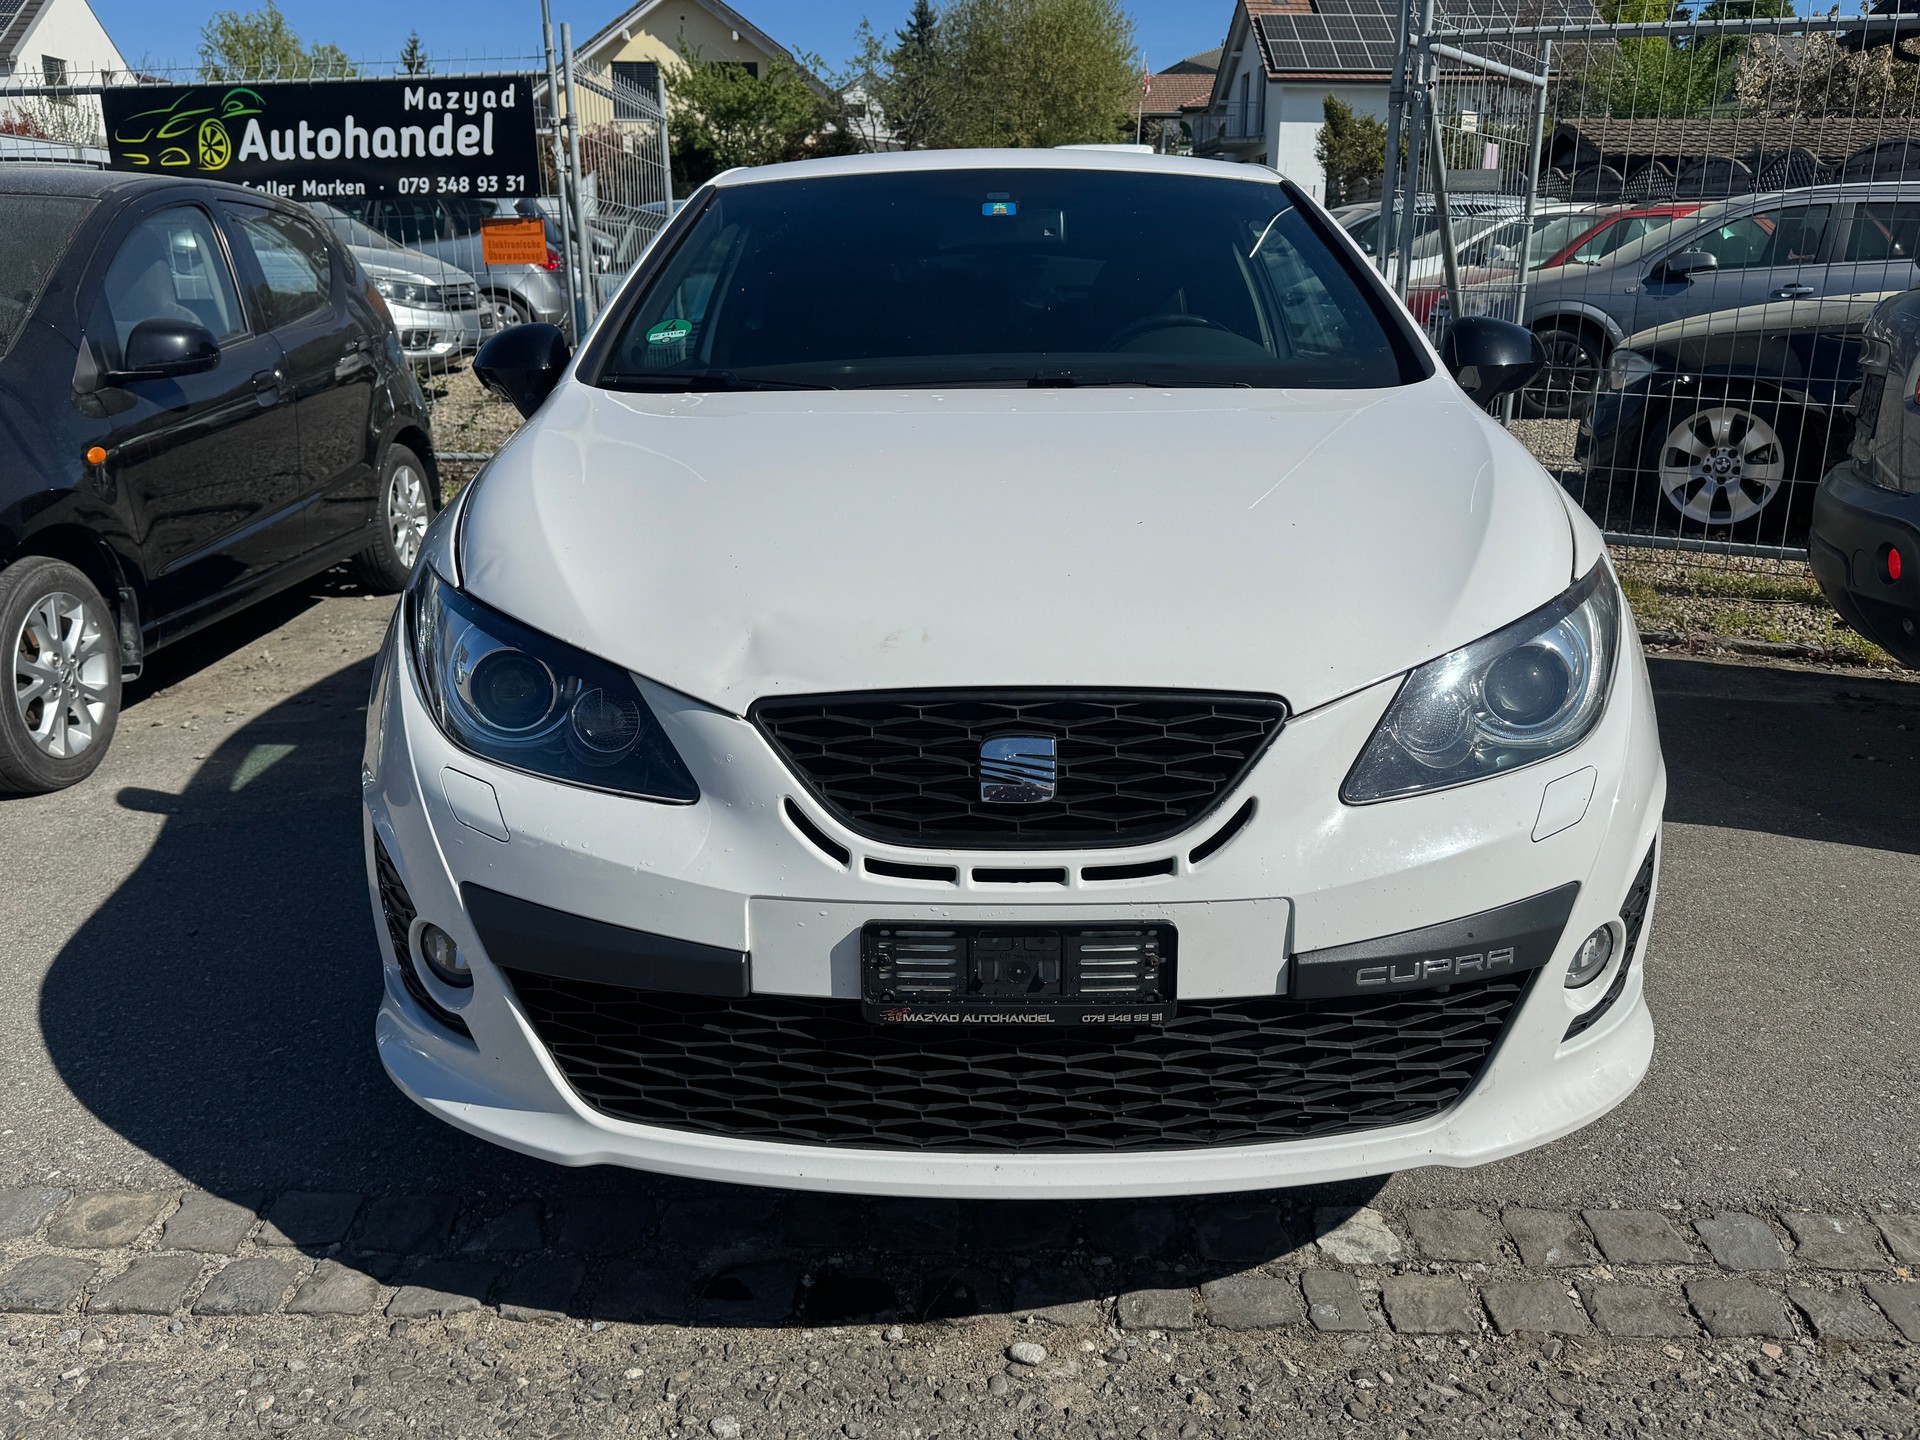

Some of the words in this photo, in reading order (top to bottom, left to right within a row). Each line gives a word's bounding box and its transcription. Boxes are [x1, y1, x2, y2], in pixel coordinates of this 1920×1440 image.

[404, 83, 515, 116] Mazyad
[238, 111, 494, 162] Autohandel
[302, 179, 366, 197] Marken
[398, 177, 430, 195] 079
[436, 176, 470, 193] 348
[477, 175, 499, 192] 93
[505, 174, 525, 192] 31
[487, 239, 542, 249] Elektronische
[488, 249, 543, 261] Überwachung!
[663, 319, 677, 331] 4
[1355, 946, 1515, 986] CUPRA
[902, 1012, 960, 1023] MAZYAD
[962, 1013, 1056, 1023] AUTOHANDEL
[1081, 1013, 1105, 1023] 079
[1107, 1013, 1131, 1022] 348
[1133, 1013, 1149, 1022] 93
[1151, 1012, 1163, 1021] 31
